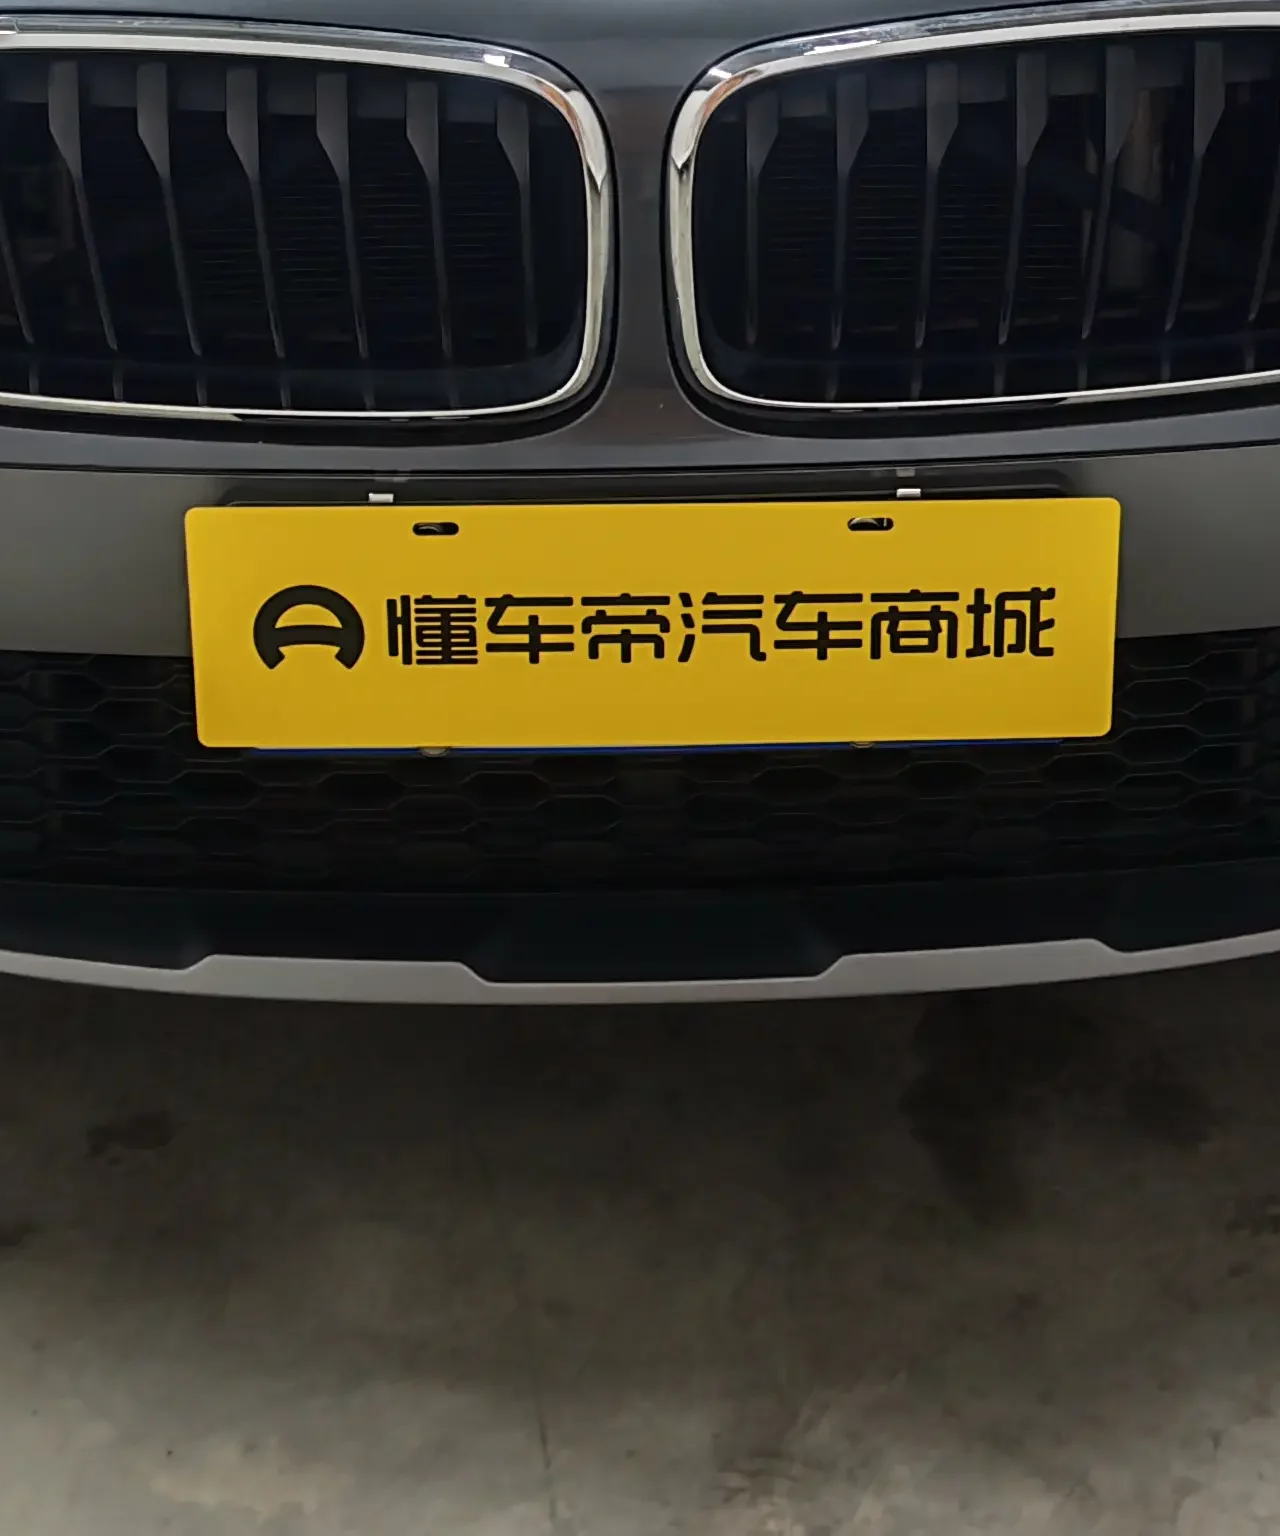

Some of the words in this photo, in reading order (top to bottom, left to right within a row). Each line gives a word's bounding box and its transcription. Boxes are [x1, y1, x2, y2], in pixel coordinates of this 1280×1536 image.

[386, 586, 1056, 666] 懂车帝汽车商城
